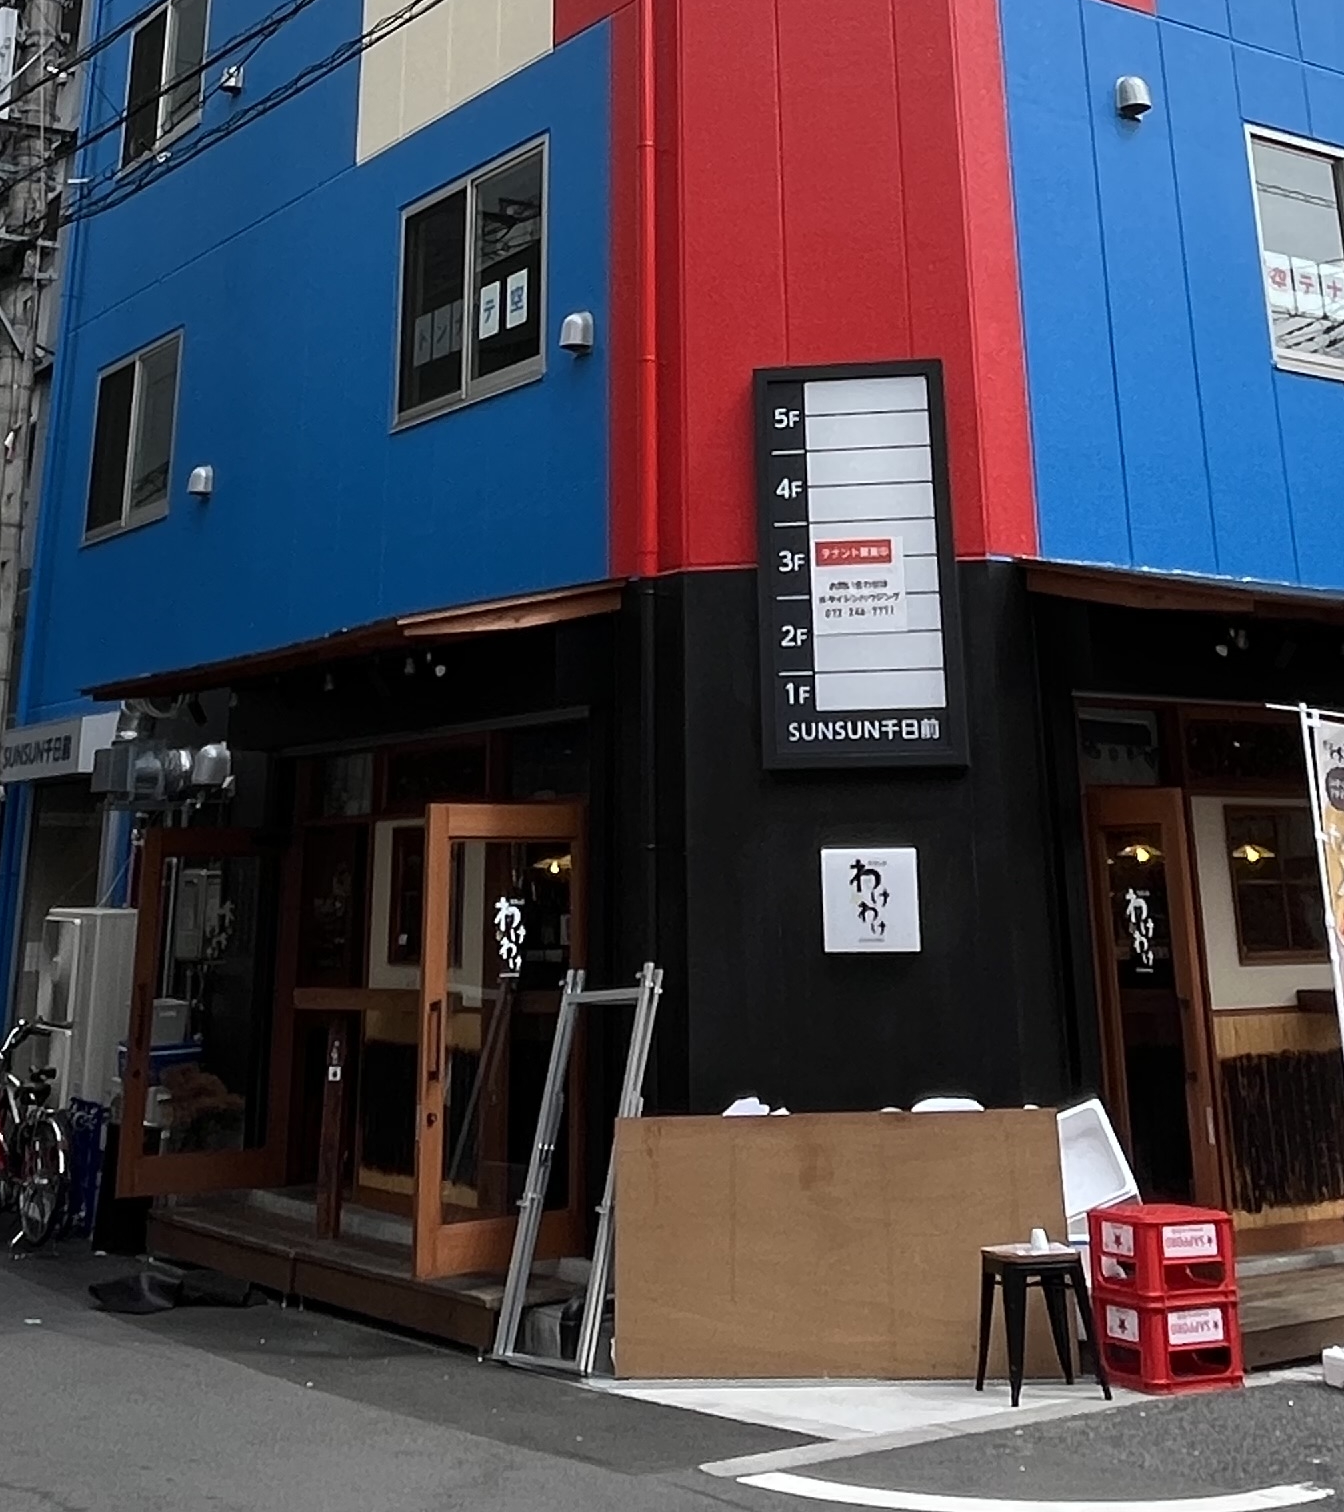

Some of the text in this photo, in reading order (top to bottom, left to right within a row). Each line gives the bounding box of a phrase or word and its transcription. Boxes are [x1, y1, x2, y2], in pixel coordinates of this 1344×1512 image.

[774, 408, 800, 429] 5F
[776, 478, 803, 500] 4F
[778, 550, 805, 572] 3F
[780, 625, 808, 648] 2F
[784, 683, 811, 705] 1F
[788, 718, 941, 741] SUNSUN千日前
[848, 858, 891, 936] わけわけ
